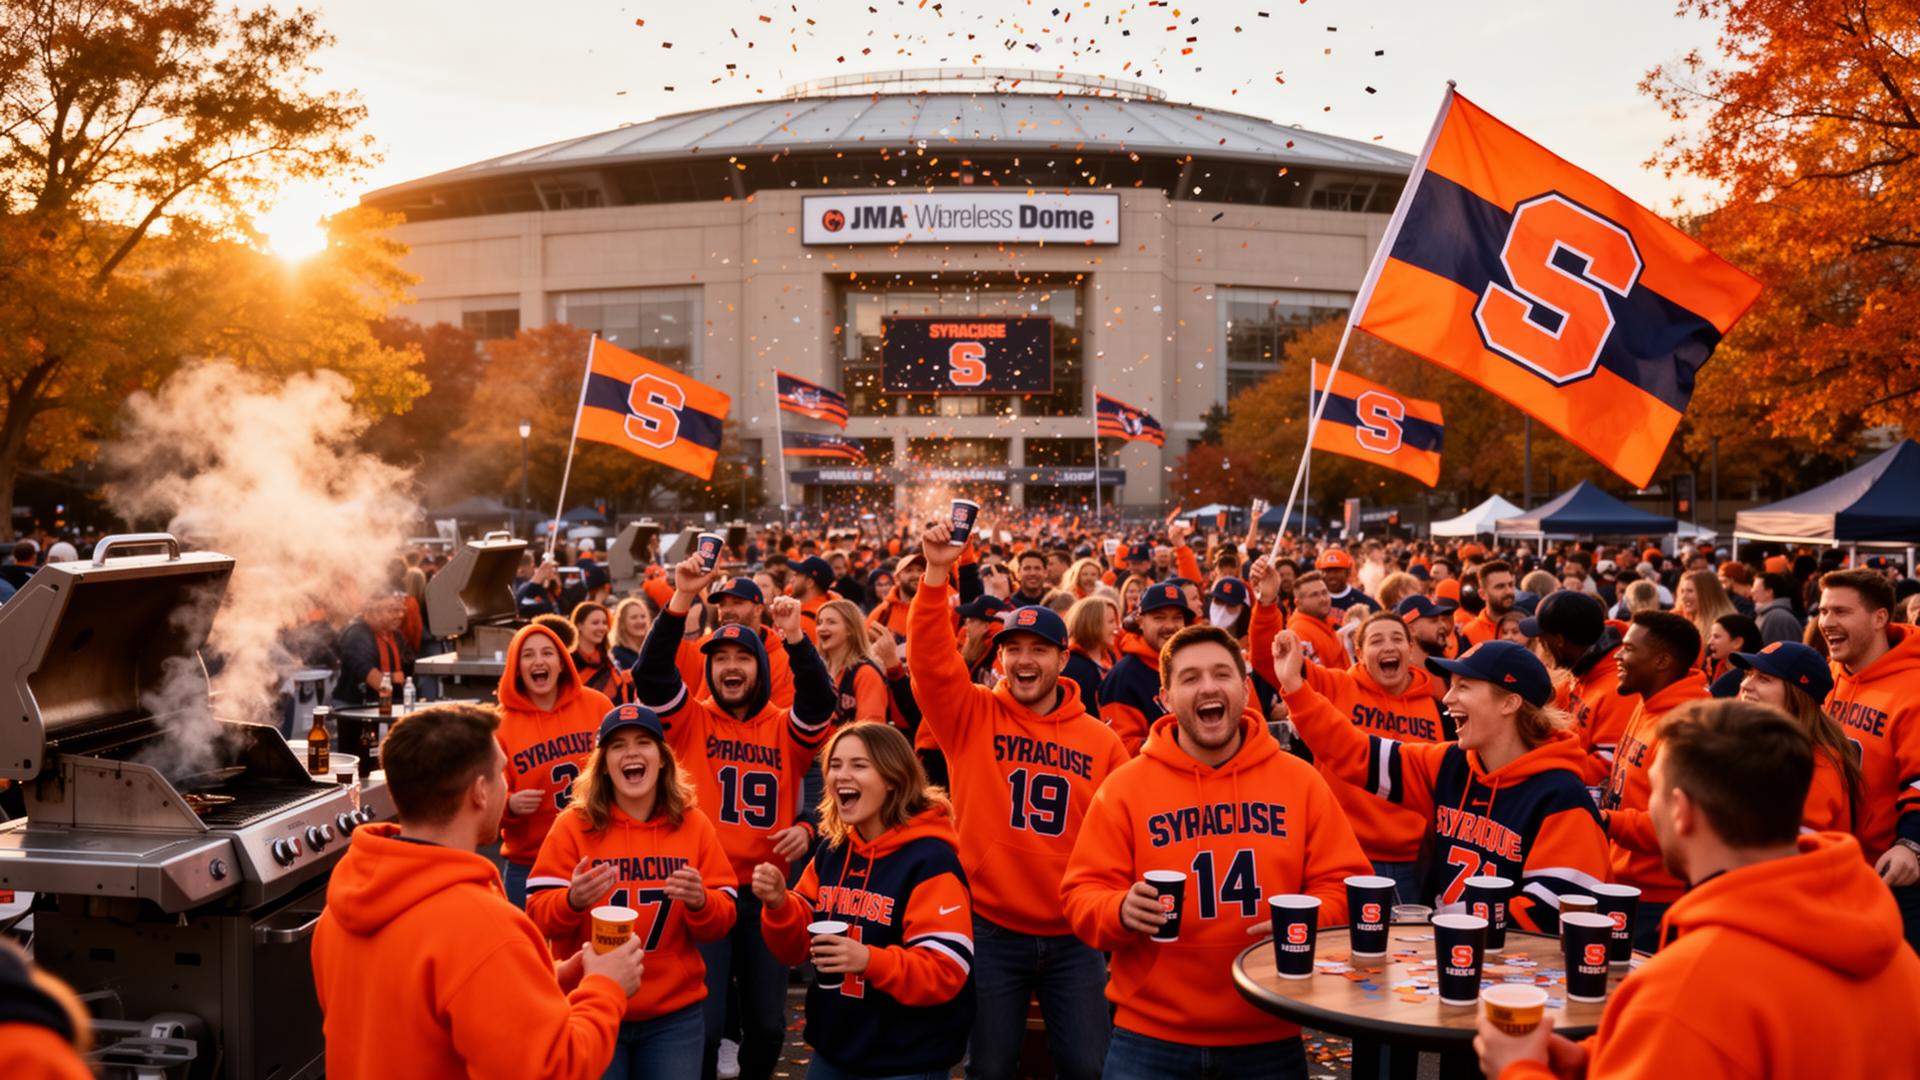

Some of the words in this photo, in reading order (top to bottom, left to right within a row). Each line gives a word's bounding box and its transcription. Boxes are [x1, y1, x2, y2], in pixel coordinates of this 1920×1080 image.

[851, 206, 906, 229] JMA
[1019, 205, 1094, 229] Dome
[1474, 191, 1643, 386] S
[929, 323, 1007, 339] SYRACUSE
[949, 342, 986, 386] S
[624, 373, 686, 449] S
[1356, 390, 1405, 454] S
[1018, 610, 1038, 626] S
[1351, 704, 1437, 741] SYRACUSE
[994, 734, 1094, 780] SYRACUSE
[718, 765, 779, 830] 19
[1008, 768, 1071, 837] 19
[1148, 802, 1288, 848] SYRACUSE
[1191, 848, 1262, 920] 14
[1287, 923, 1308, 944] S
[1361, 903, 1381, 923] S
[1451, 945, 1473, 967] S
[1583, 944, 1606, 965] S
